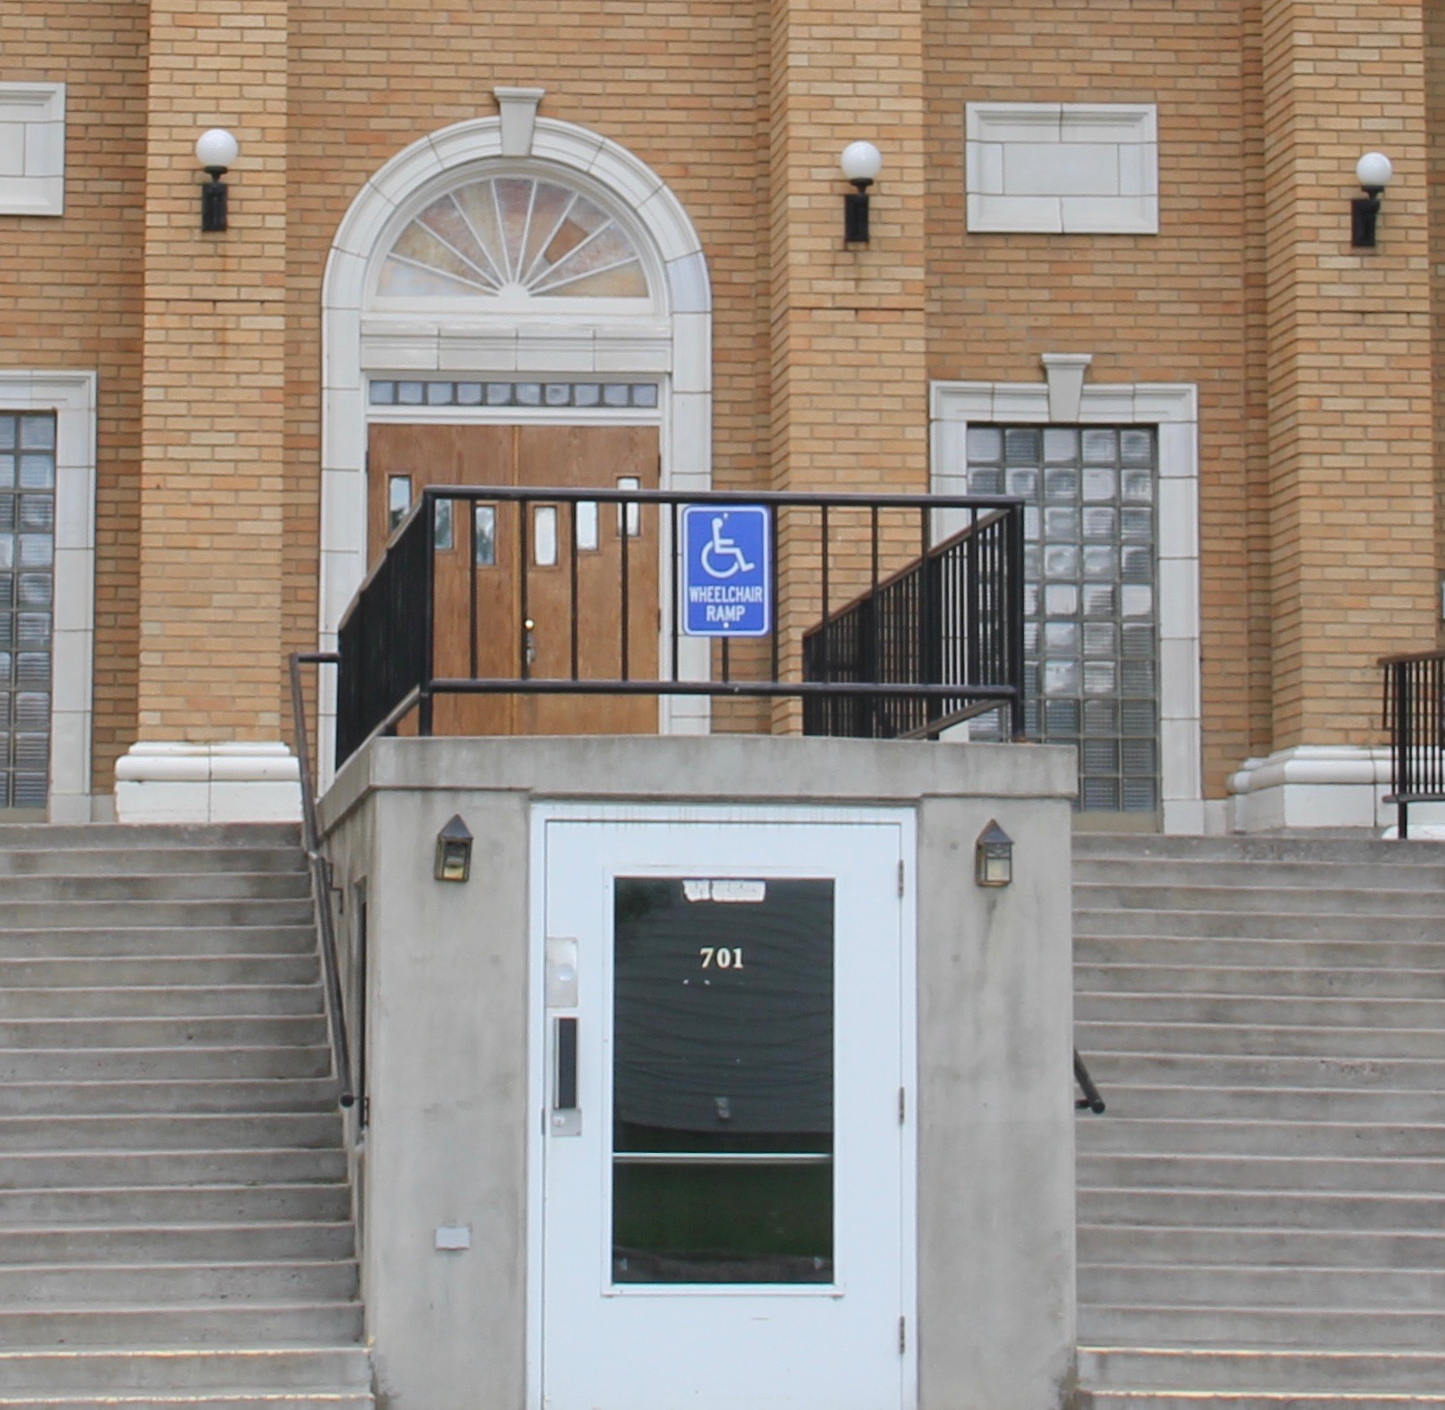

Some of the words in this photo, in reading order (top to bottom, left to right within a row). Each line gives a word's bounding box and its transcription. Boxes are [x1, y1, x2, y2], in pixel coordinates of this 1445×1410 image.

[689, 586, 763, 603] WHEELCHAIR
[706, 605, 746, 622] RAMP
[700, 947, 743, 968] 701
